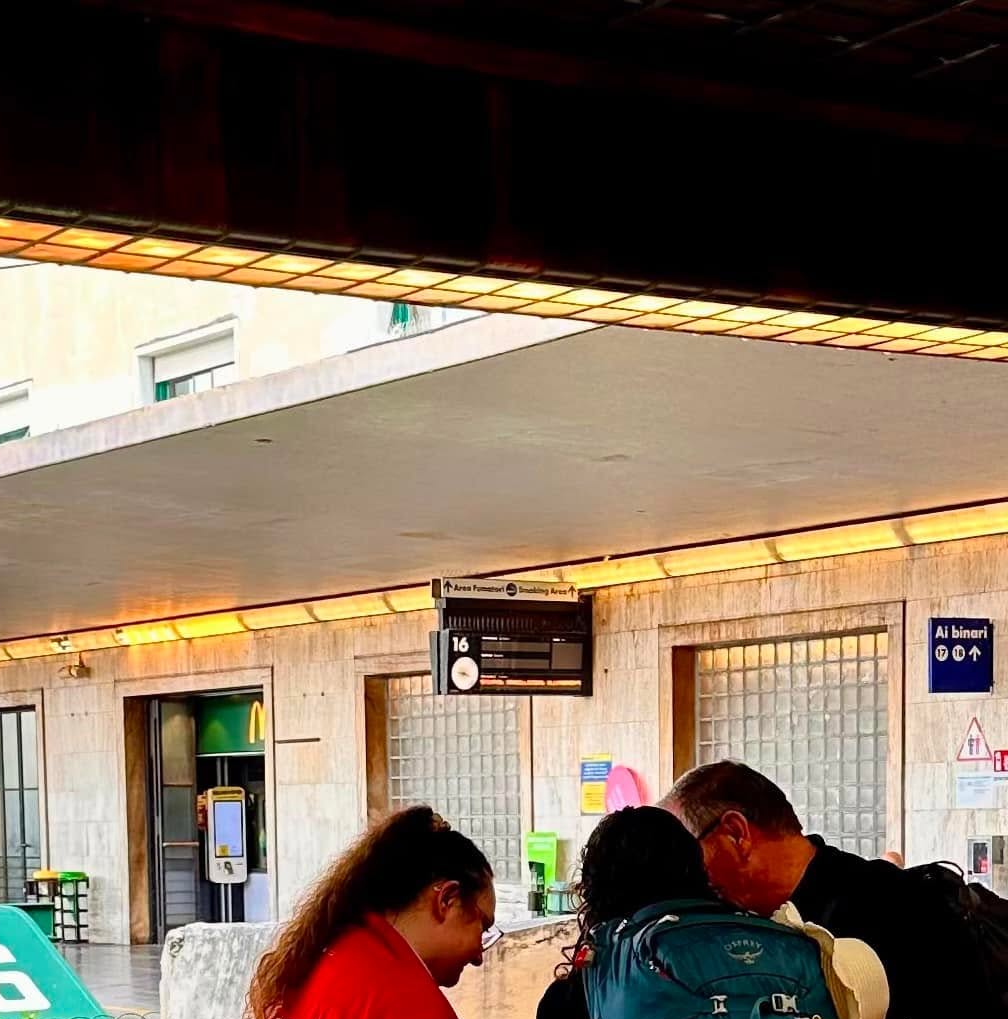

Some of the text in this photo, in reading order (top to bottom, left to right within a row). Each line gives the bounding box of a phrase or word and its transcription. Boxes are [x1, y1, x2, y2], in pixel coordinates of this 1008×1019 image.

[454, 583, 471, 592] Area
[550, 587, 567, 595] Area
[935, 624, 988, 639] Ai binari
[452, 636, 469, 653] 16
